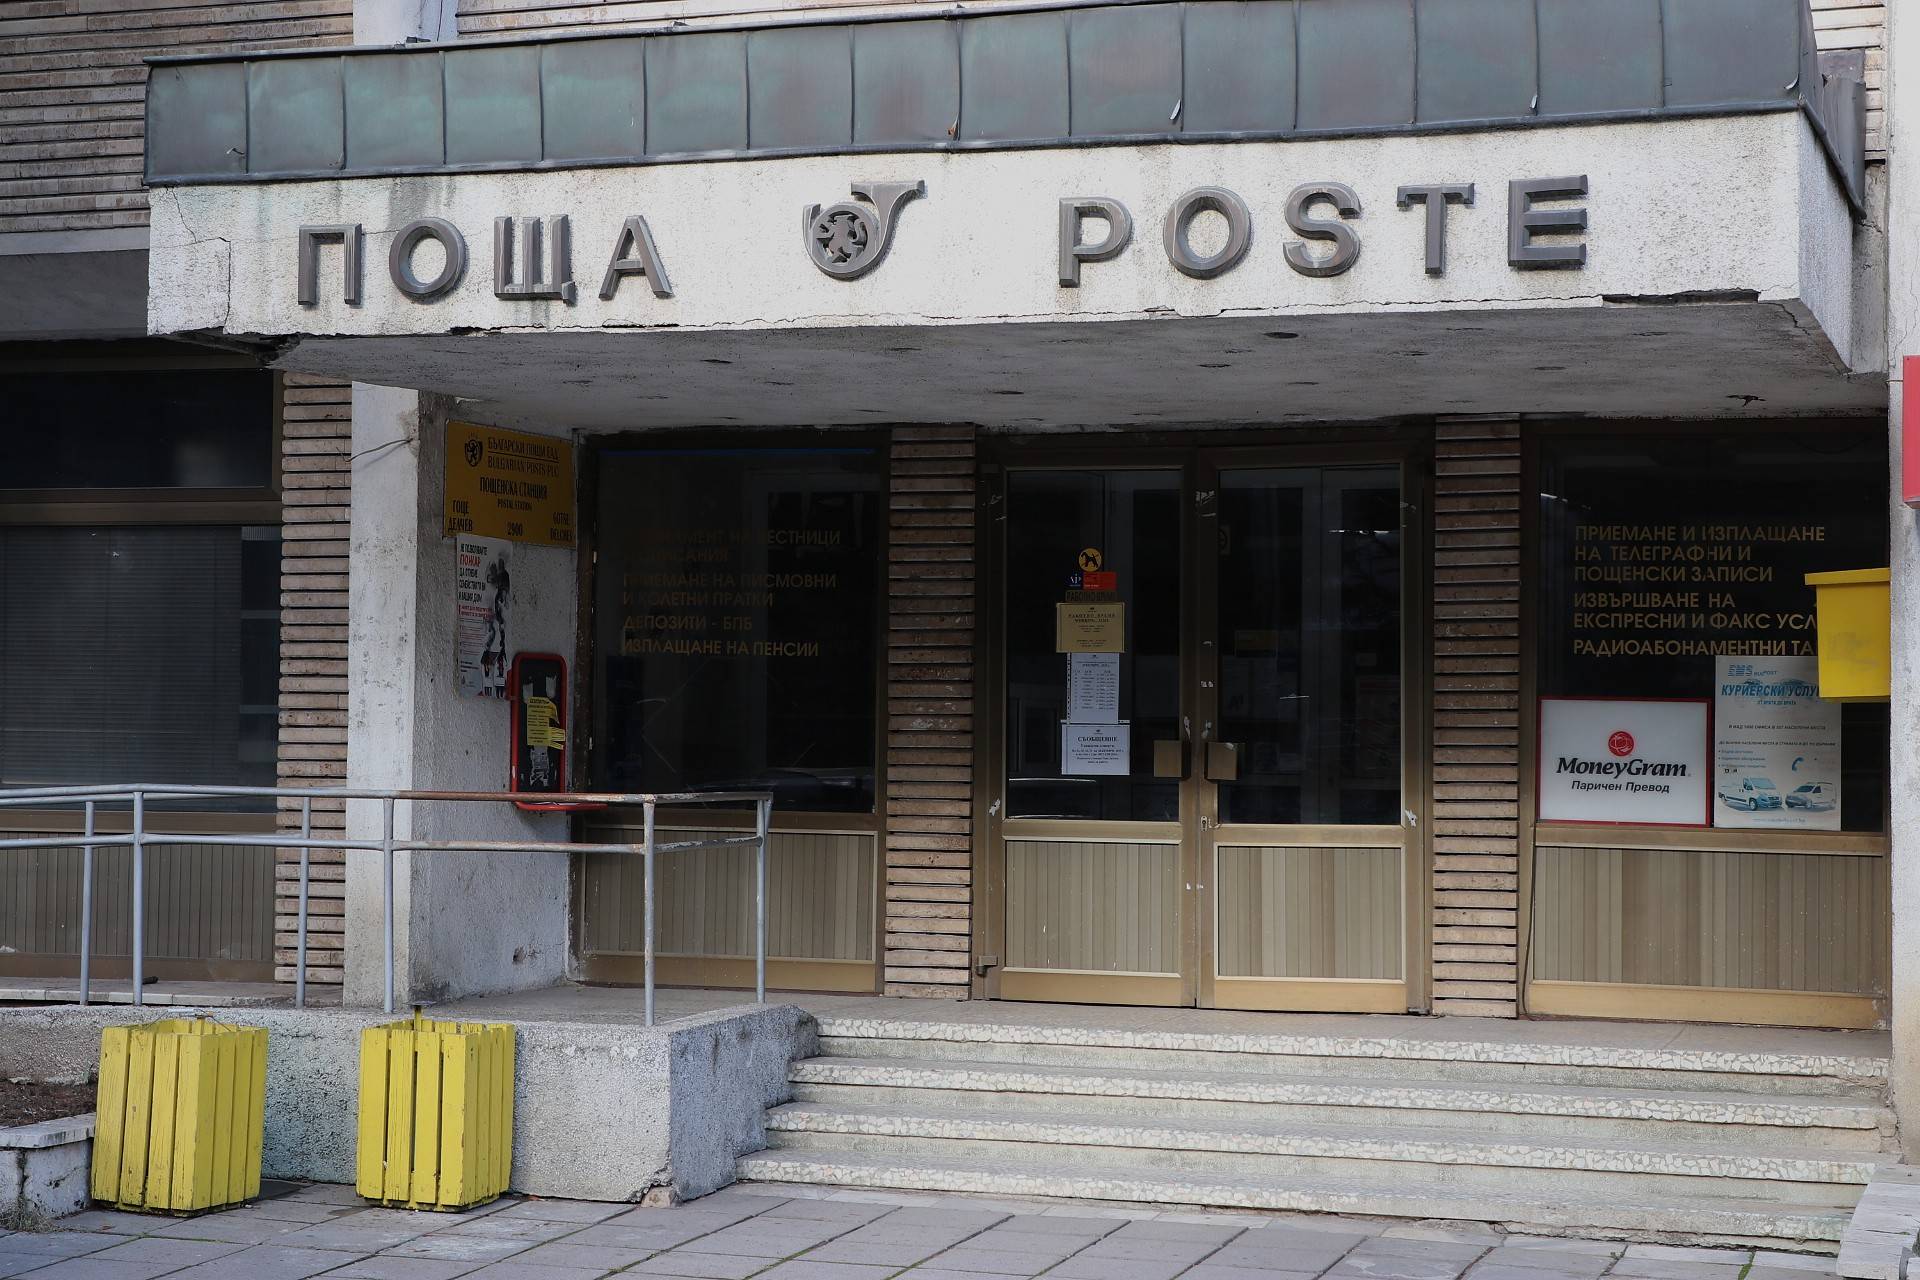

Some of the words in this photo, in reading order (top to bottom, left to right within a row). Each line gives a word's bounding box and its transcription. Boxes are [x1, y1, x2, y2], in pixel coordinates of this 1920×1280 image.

[1058, 175, 1589, 288] POSTE
[298, 214, 673, 307] ПОЩА
[488, 437, 525, 454] БЪЛГАРСКИ
[488, 456, 525, 473] BULGARIAN
[526, 462, 546, 476] POSTS
[480, 477, 518, 496] ПОЩЕНСКА
[519, 481, 548, 501] СТАНЦИЯ
[453, 500, 469, 516] ГОЦЕ
[448, 517, 473, 532] ДЕЛЧЕВ
[553, 511, 569, 525] GOTSE
[507, 521, 523, 537] 2900
[1575, 525, 1676, 541] ПРИЕМАНЕ
[1682, 525, 1696, 541] И
[1702, 525, 1825, 542] ИЗПЛАЩАНЕ
[460, 554, 480, 567] ПОЖАР
[1575, 545, 1602, 561] НА
[1610, 545, 1732, 563] ТЕЛЕГРАФНИ
[1738, 545, 1751, 561] И
[713, 573, 736, 588] НА
[740, 573, 837, 589] ПИСМОВНИ
[1574, 565, 1686, 584] ПОЩЕНСКИ
[1691, 565, 1773, 583] ЗАПИСИ
[623, 591, 634, 607] И
[713, 592, 774, 608] ПРАТКИ
[1573, 592, 1699, 608] ИЗВЪРШВАНЕ
[1708, 592, 1736, 608] НА
[623, 615, 706, 630] ДЕПОЗИТИ
[723, 615, 753, 631] БПБ
[1573, 612, 1686, 629] ЕКСПРЕСНИ
[1692, 612, 1705, 628] И
[1709, 612, 1771, 630] ФАКС
[622, 638, 722, 656] ИЗПЛАЩАНЕ
[727, 639, 749, 655] НА
[752, 640, 819, 657] ПЕНСИИ
[1573, 640, 1786, 657] РАДИОАБОНАМЕНТНИ
[1721, 684, 1787, 697] КУРИЕРСКИ
[1556, 757, 1687, 779] MoneyGram
[1571, 780, 1622, 792] Паричен
[1625, 782, 1670, 794] Превод
